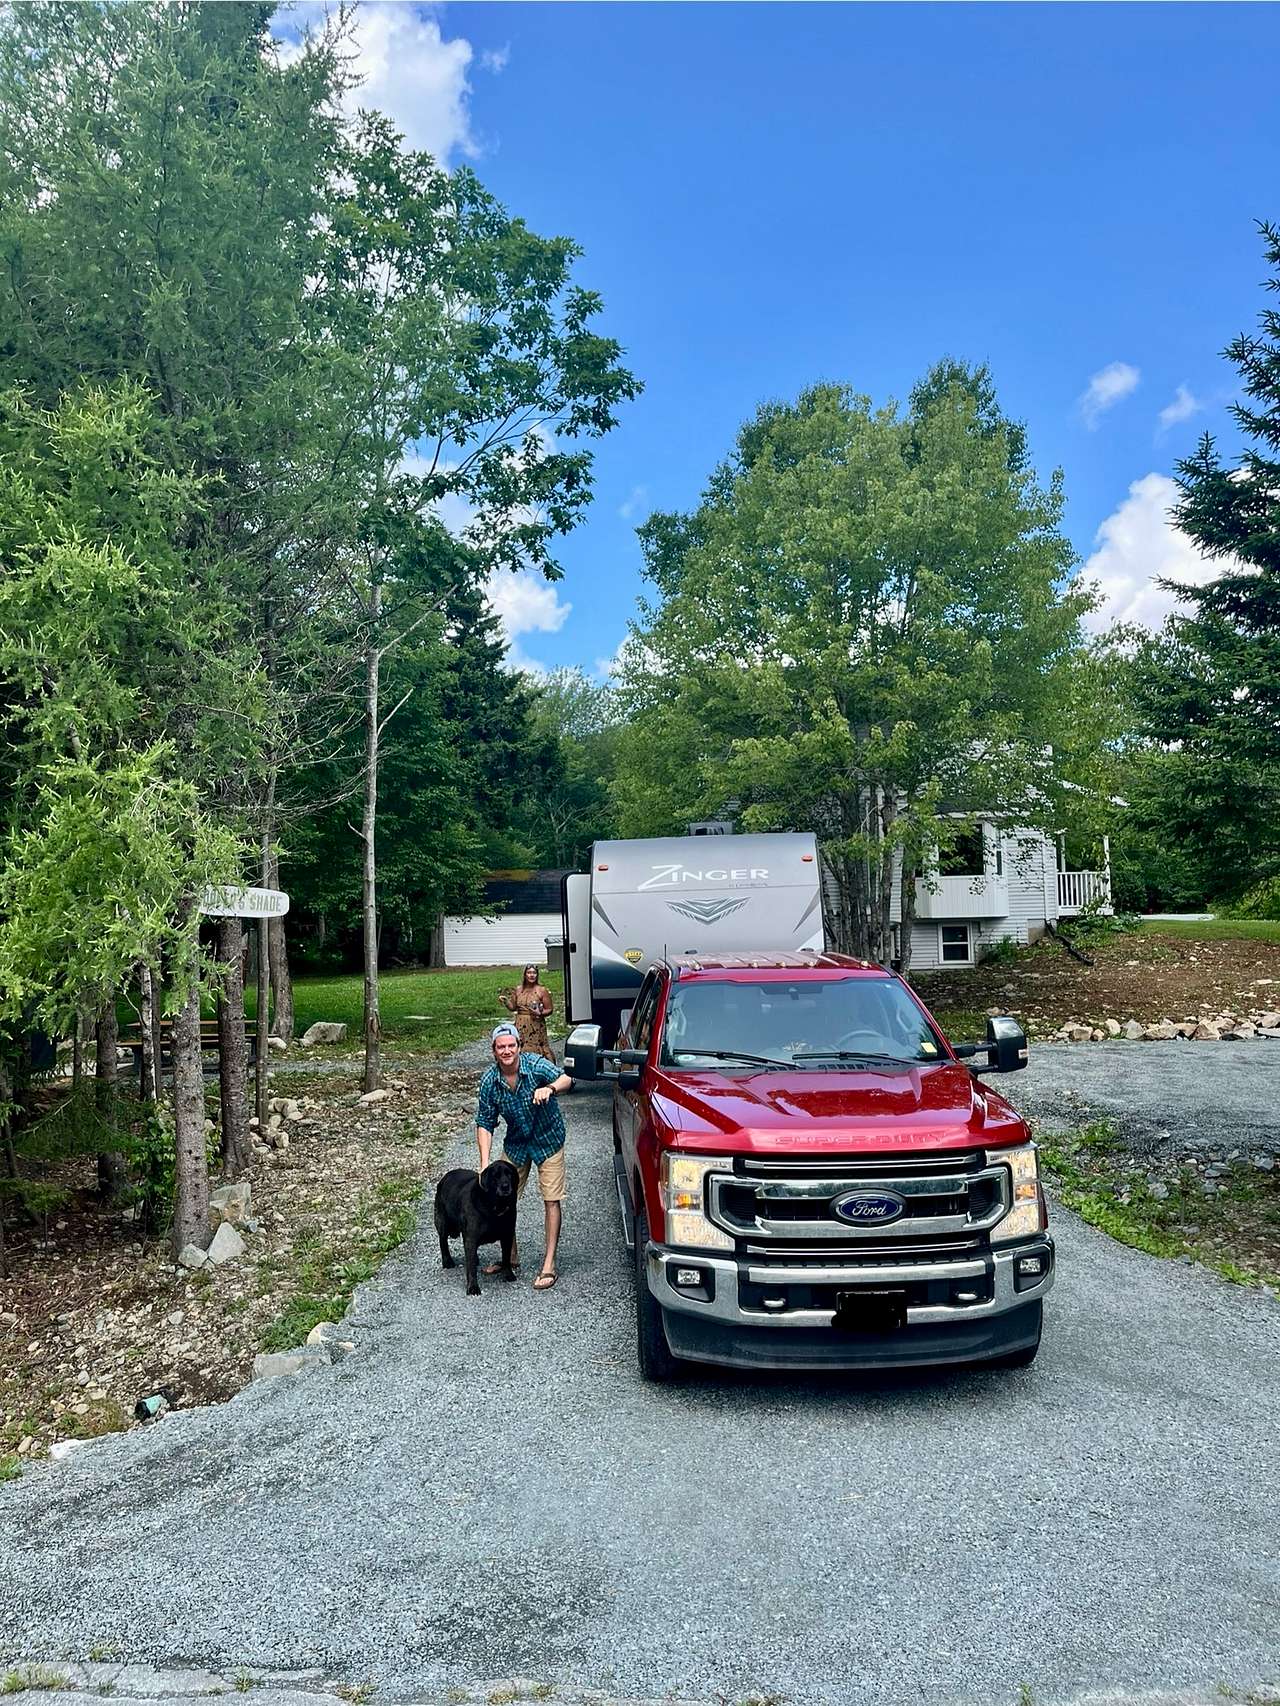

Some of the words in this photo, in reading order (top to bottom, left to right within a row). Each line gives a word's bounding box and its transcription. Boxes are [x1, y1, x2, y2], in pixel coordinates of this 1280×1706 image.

[637, 864, 769, 890] ZINGER
[249, 891, 283, 913] SHADE
[852, 1200, 887, 1216] Ford
